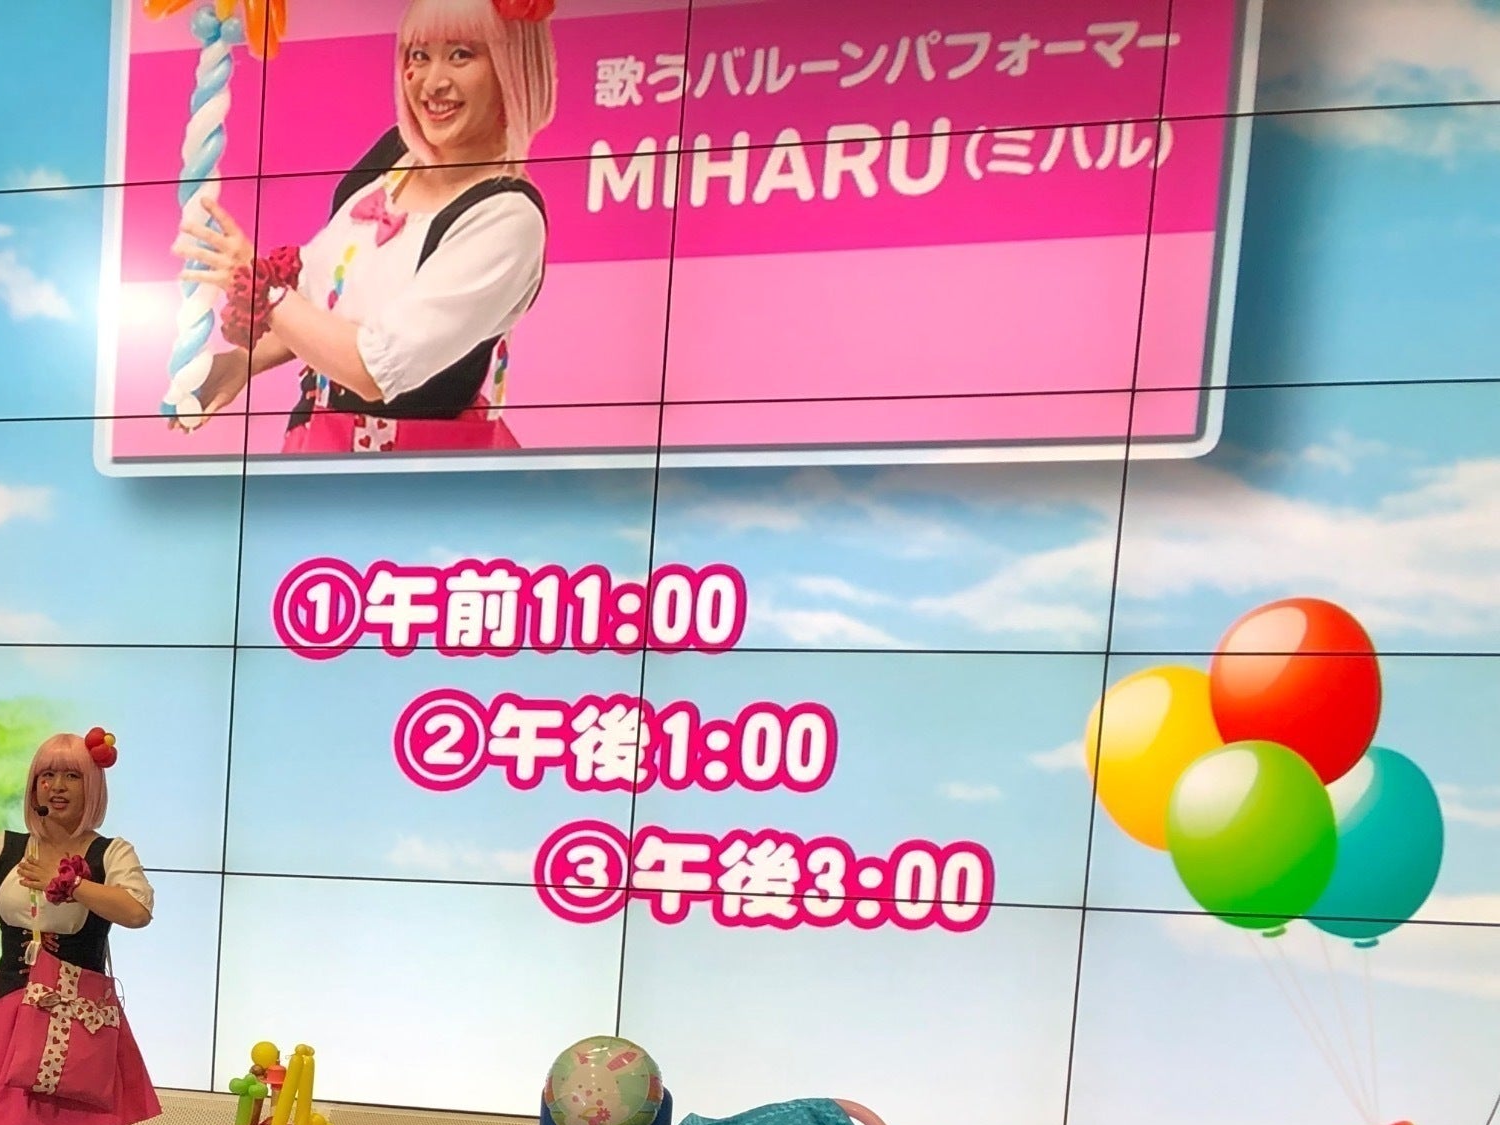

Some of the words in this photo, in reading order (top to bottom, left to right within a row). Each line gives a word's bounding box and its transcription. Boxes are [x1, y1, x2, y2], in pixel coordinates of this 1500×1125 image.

[593, 20, 1181, 109] 歌うバルーンパフォーマー
[586, 116, 952, 213] MIHARU
